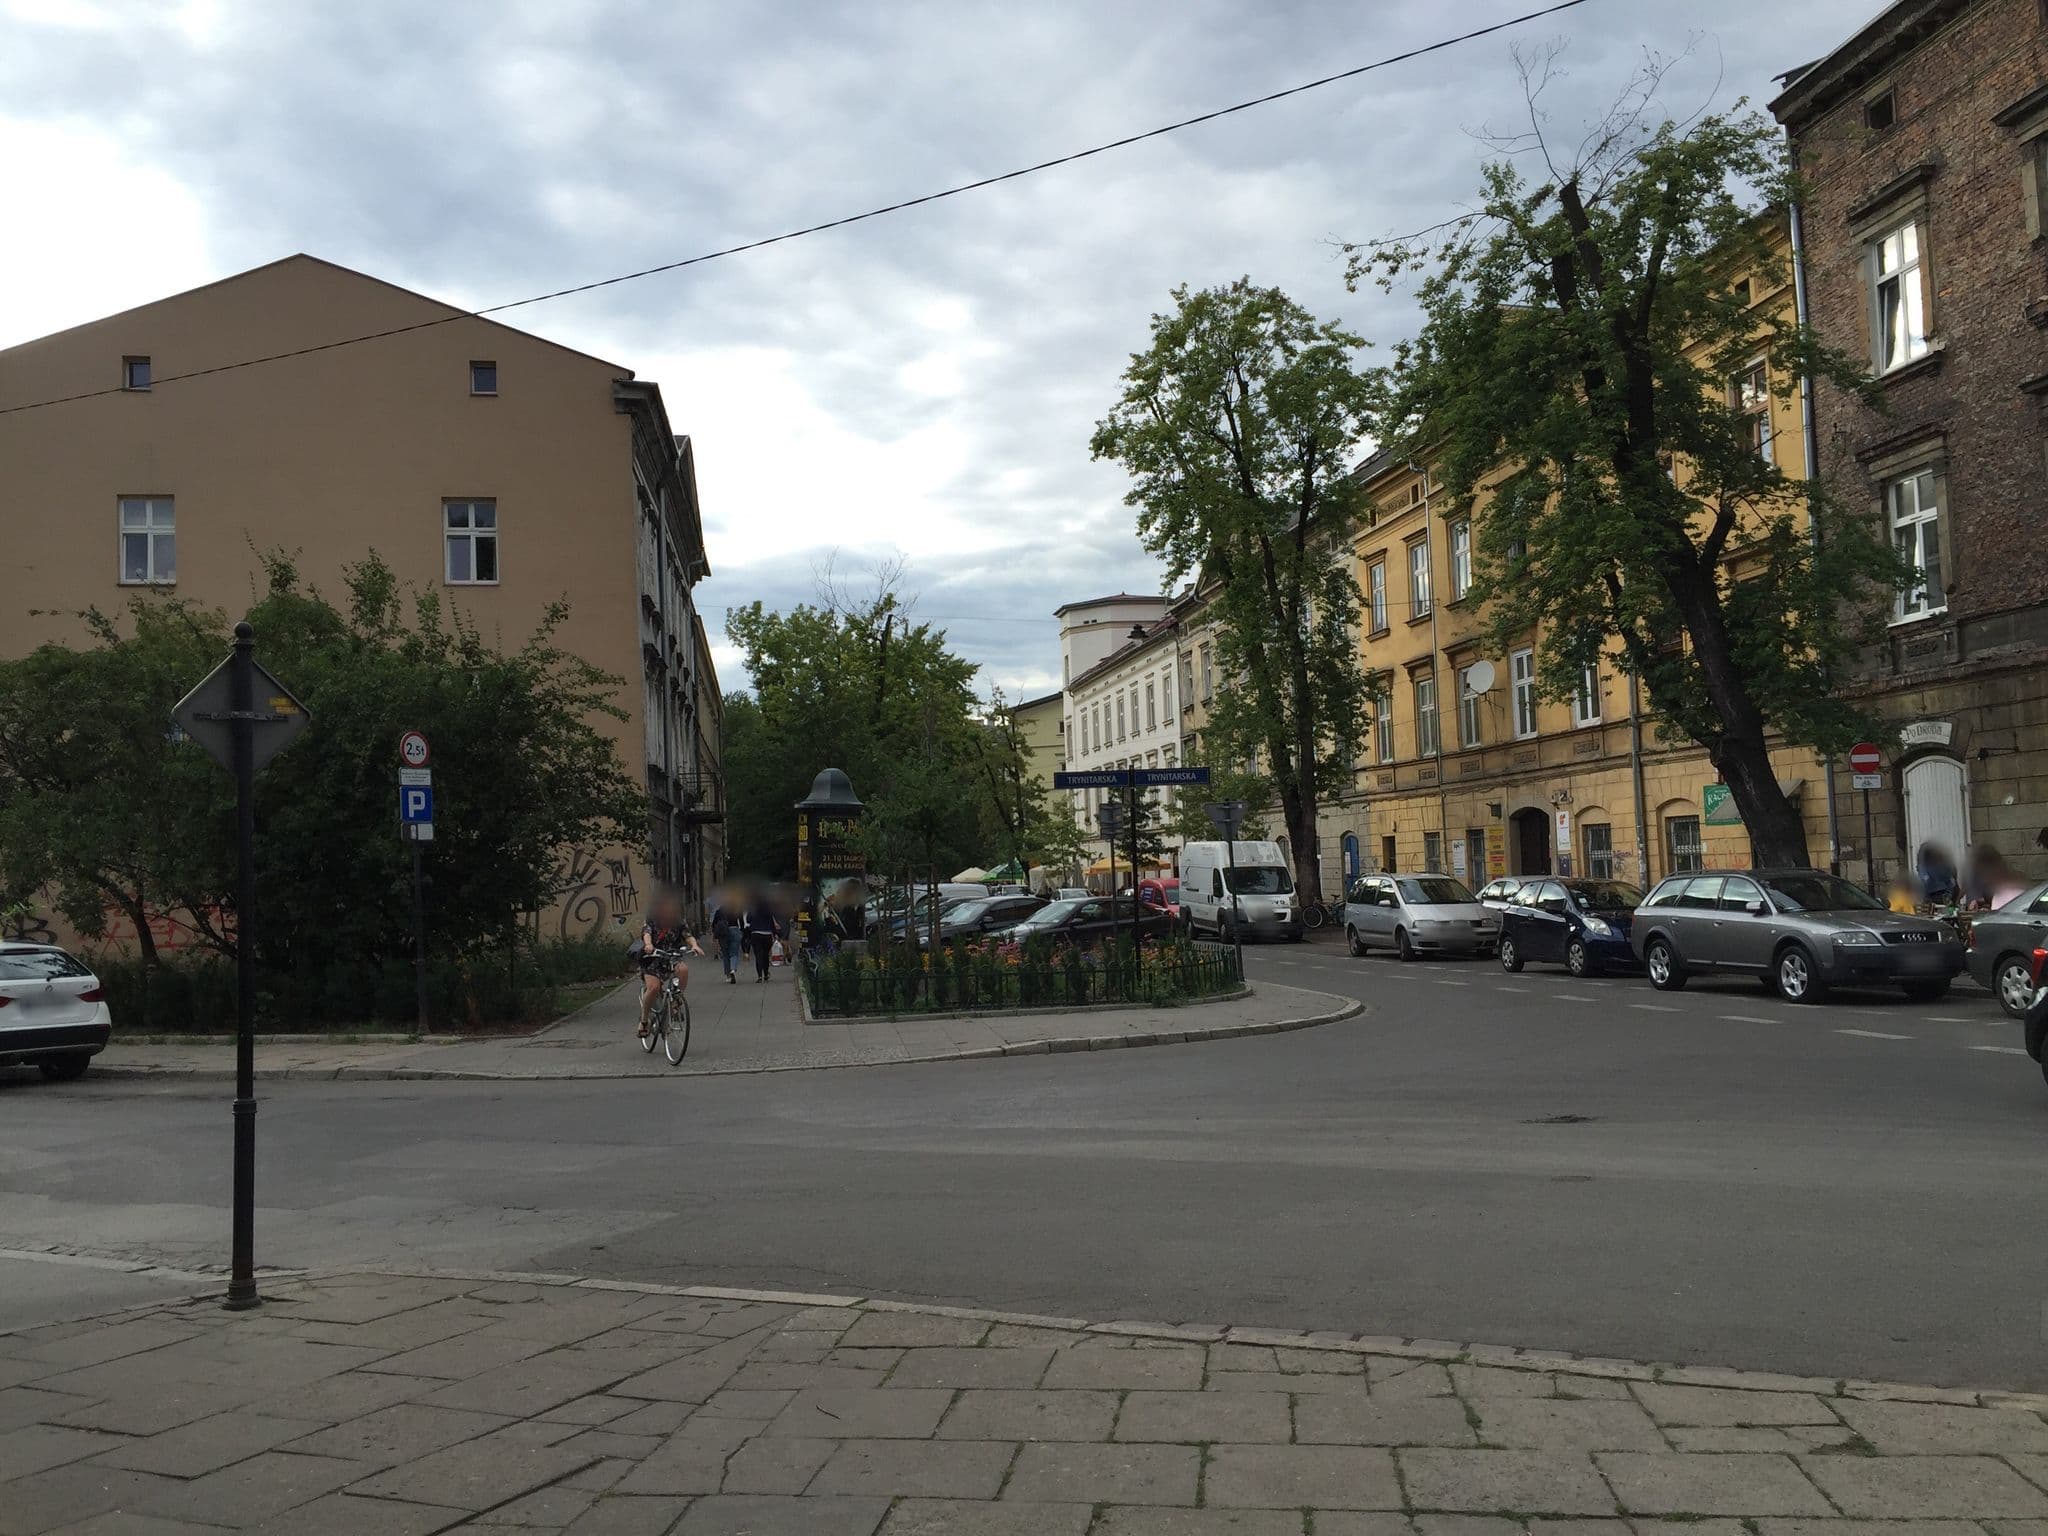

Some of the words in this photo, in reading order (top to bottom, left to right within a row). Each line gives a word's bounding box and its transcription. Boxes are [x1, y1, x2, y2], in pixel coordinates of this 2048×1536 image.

[1068, 775, 1117, 785] TRYNITARSKA
[1147, 772, 1197, 782] TRYNITARSKA
[408, 790, 426, 818] P
